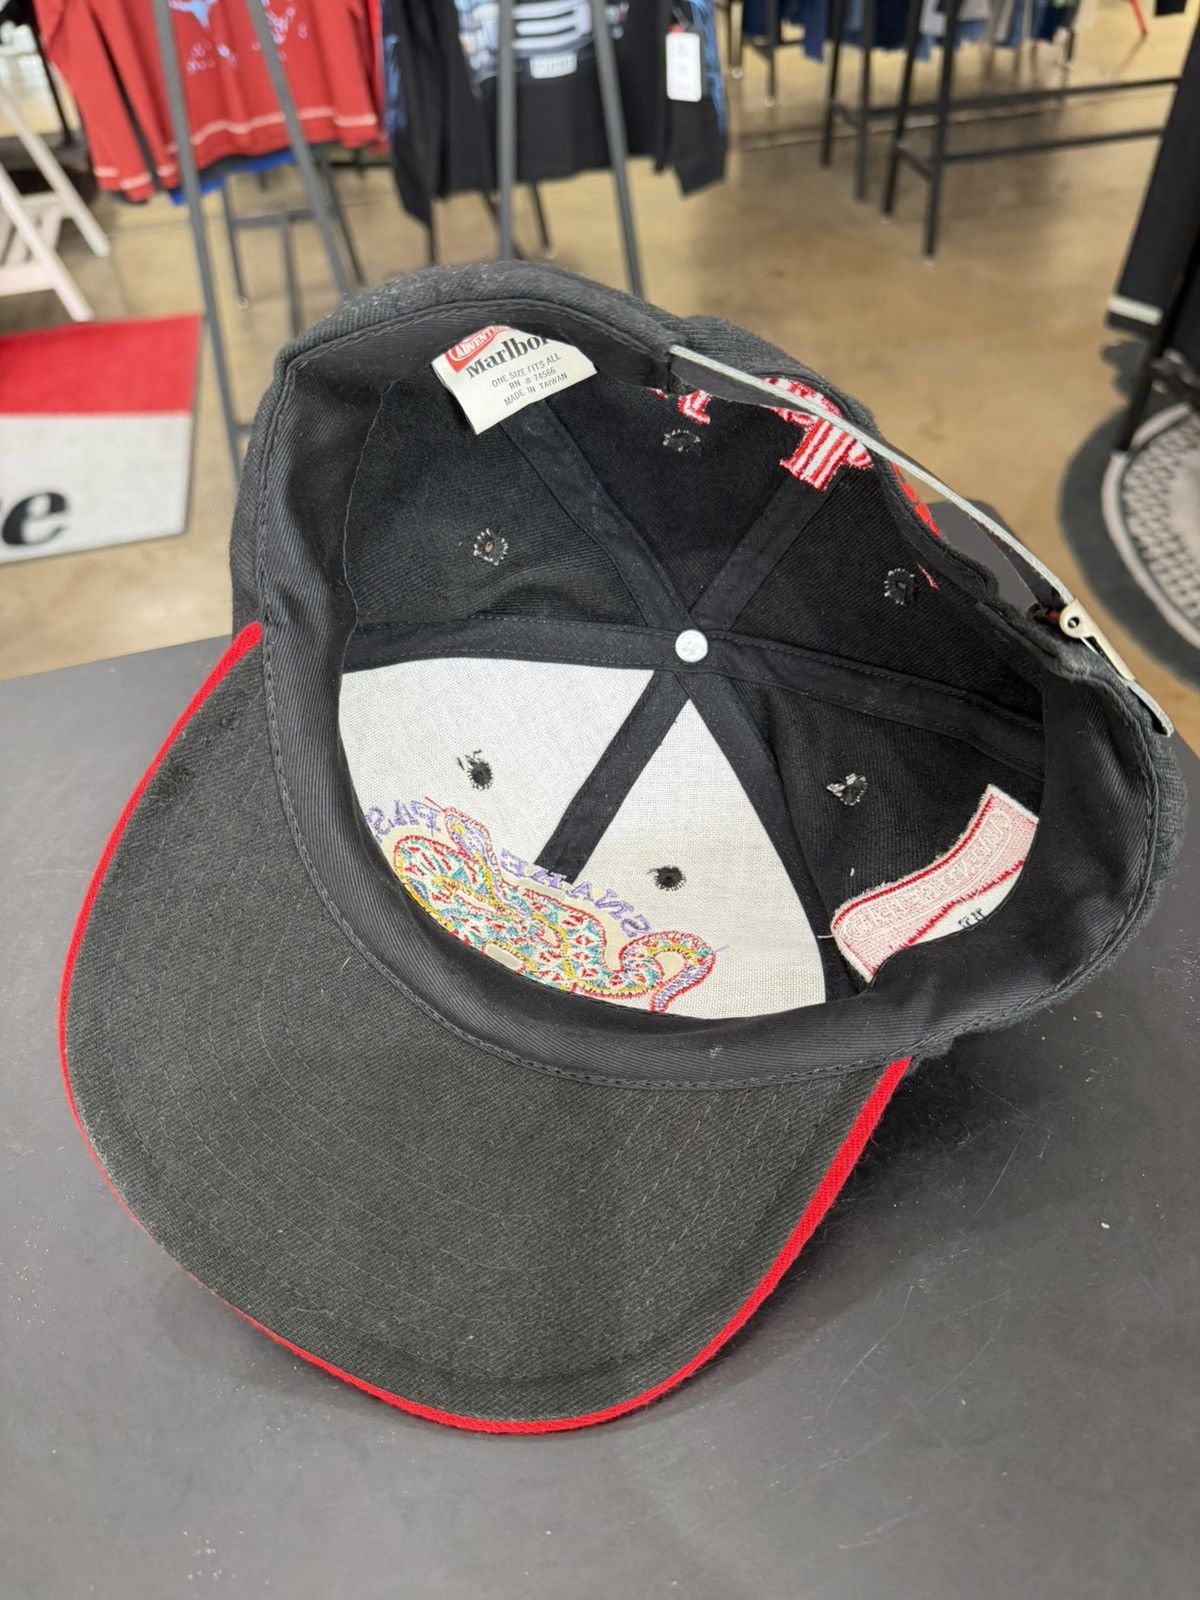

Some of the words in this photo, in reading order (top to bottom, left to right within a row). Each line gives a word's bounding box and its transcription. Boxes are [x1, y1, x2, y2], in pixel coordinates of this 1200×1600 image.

[491, 374, 508, 388] ONE
[508, 368, 526, 381] SIZE
[526, 360, 545, 374] FITS
[546, 353, 562, 366] ALL
[508, 380, 521, 390] RN
[533, 367, 556, 382] 74566
[503, 389, 525, 407] MADE
[526, 385, 536, 394] IN
[539, 372, 568, 390] TAIWAN
